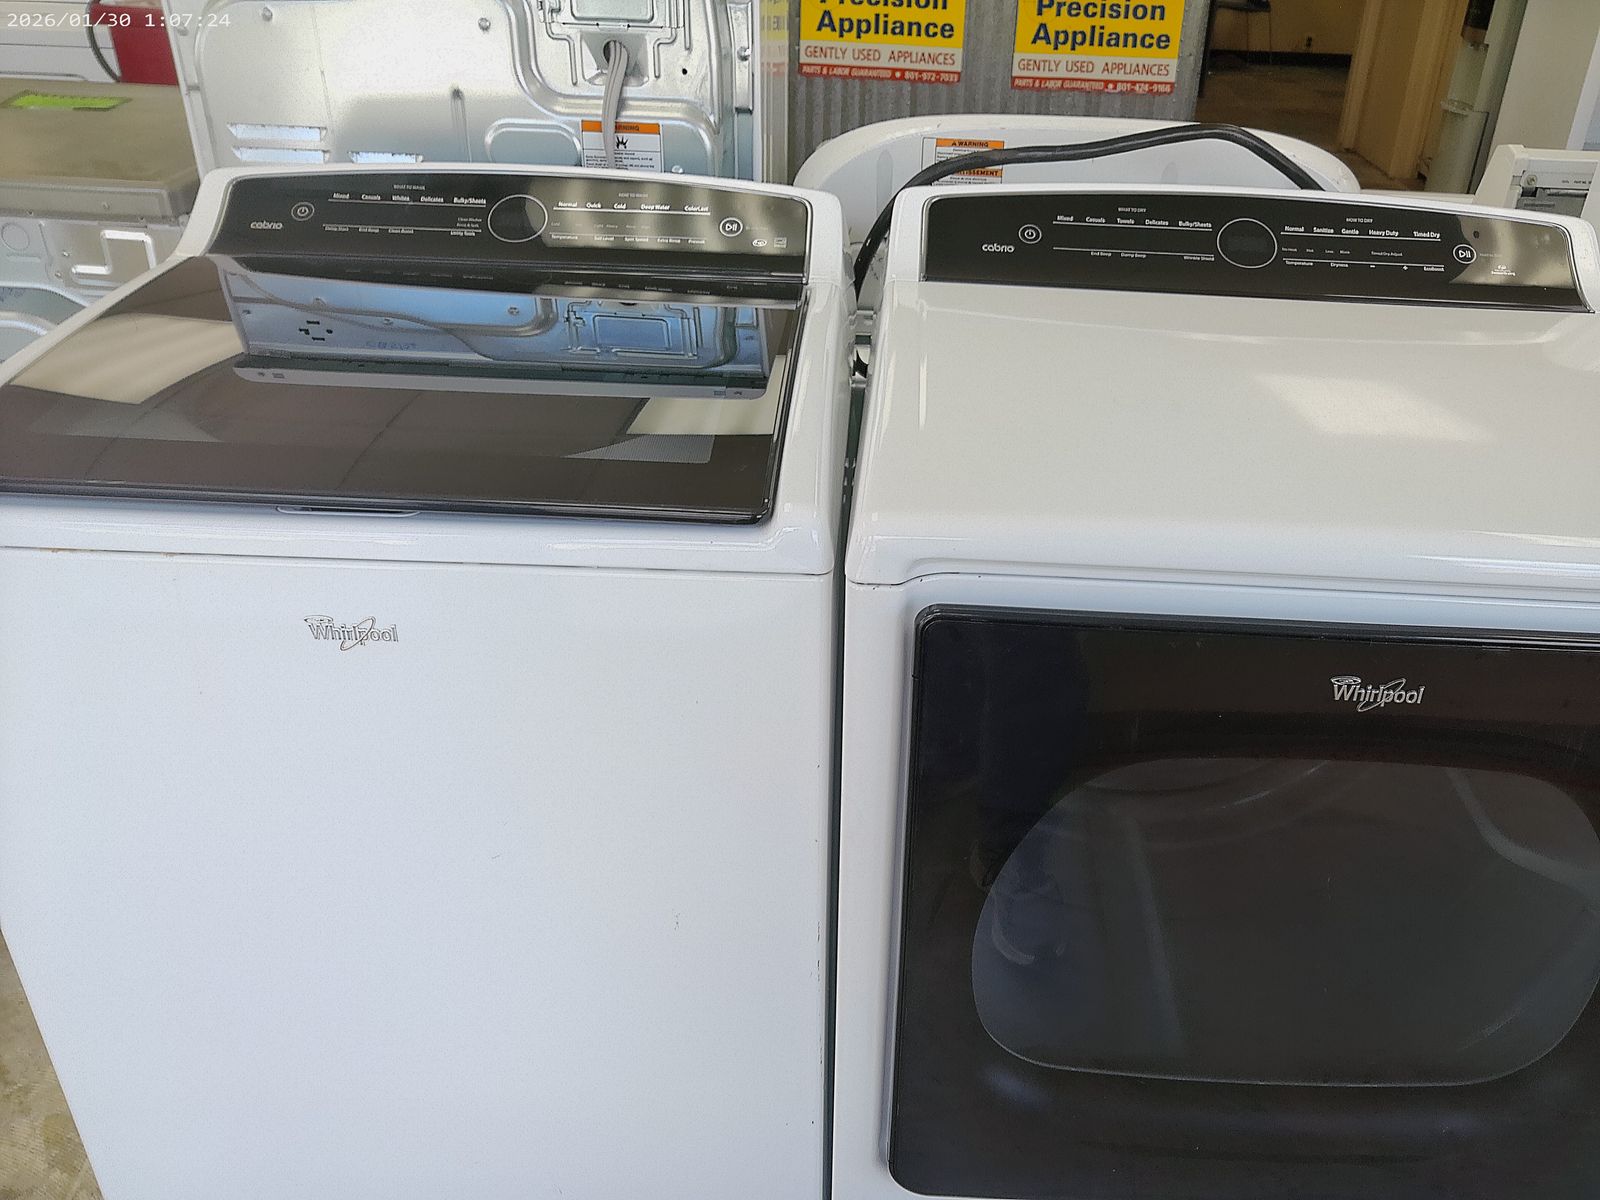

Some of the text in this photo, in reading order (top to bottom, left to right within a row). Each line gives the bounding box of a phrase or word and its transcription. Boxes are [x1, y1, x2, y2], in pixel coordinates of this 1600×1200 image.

[1036, 0, 1165, 21] Precision
[816, 10, 955, 39] Appliance
[1031, 23, 1171, 51] Appliance
[804, 45, 956, 66] GENTLY USED APPLIANCES
[1018, 58, 1170, 77] GENTLY USED APPLIANCES
[958, 140, 989, 148] WARNING
[250, 219, 284, 230] cabrio
[982, 242, 1015, 253] cabrio
[305, 618, 400, 647] Whirlpool
[1332, 680, 1426, 708] Whirlpool
